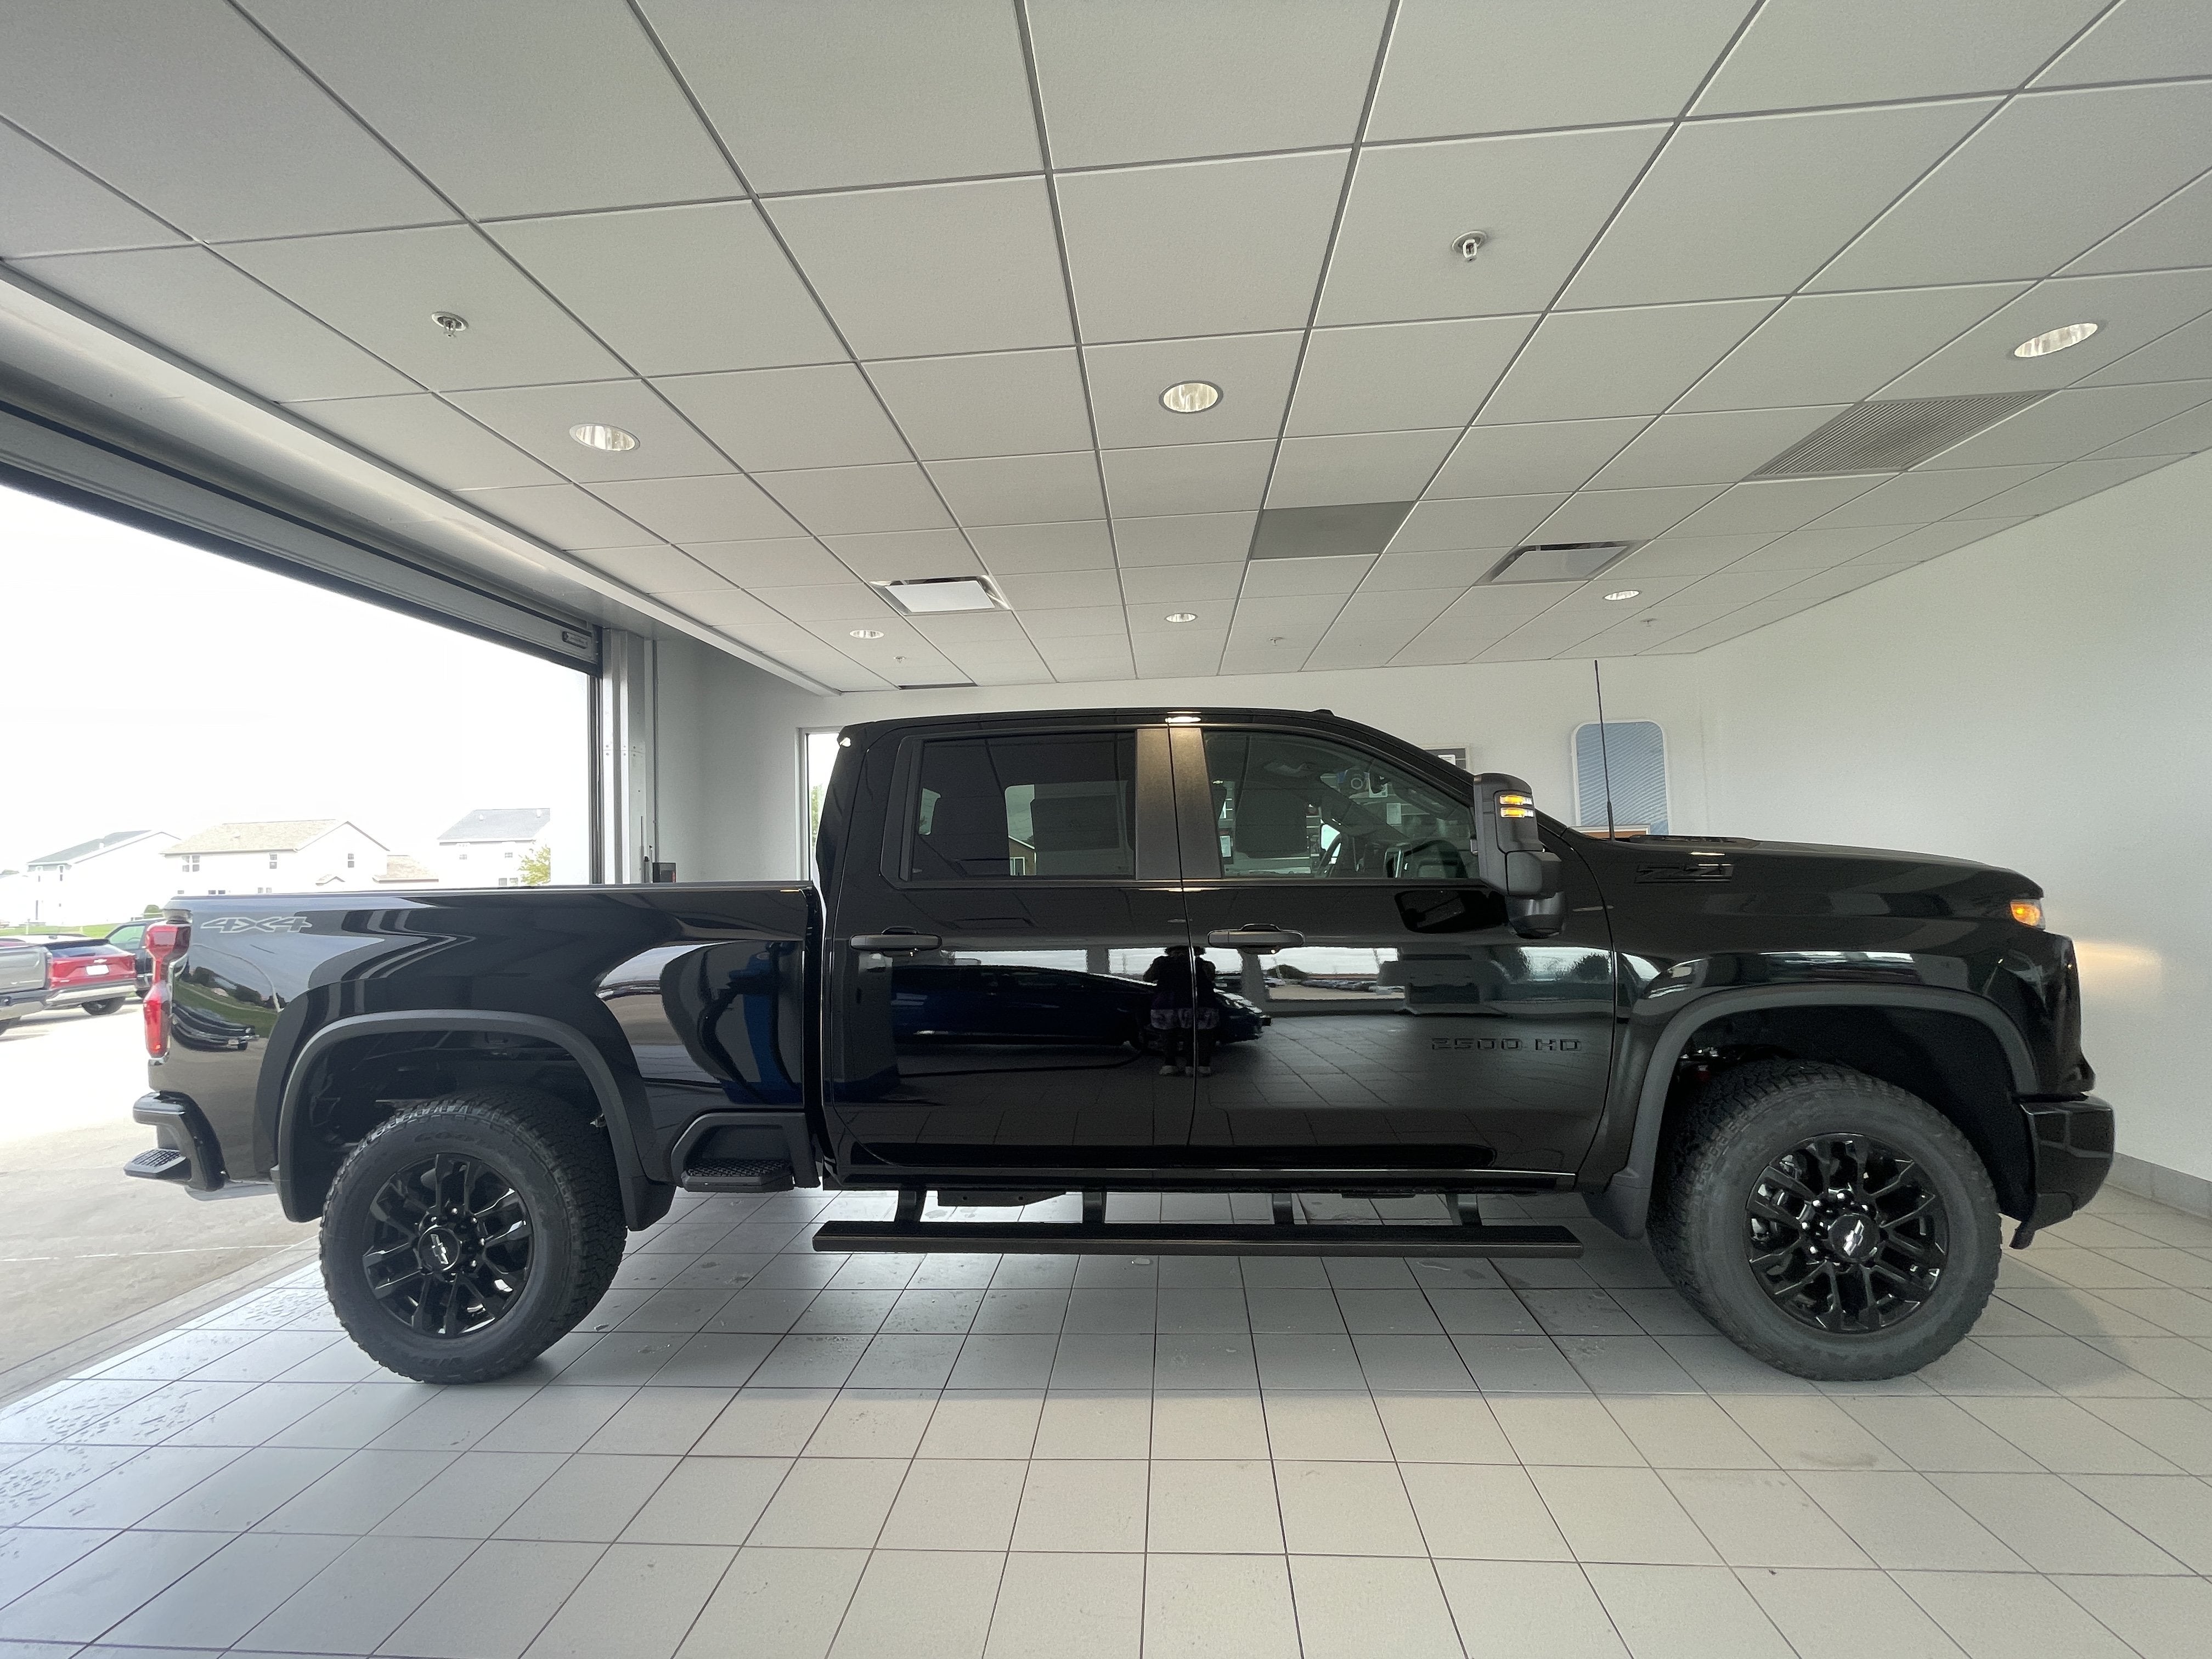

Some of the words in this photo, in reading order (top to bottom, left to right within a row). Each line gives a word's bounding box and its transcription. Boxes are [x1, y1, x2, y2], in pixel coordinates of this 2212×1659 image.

[200, 916, 313, 934] 4X4
[1432, 1038, 1522, 1051] 2500
[1535, 1039, 1581, 1052] HD
